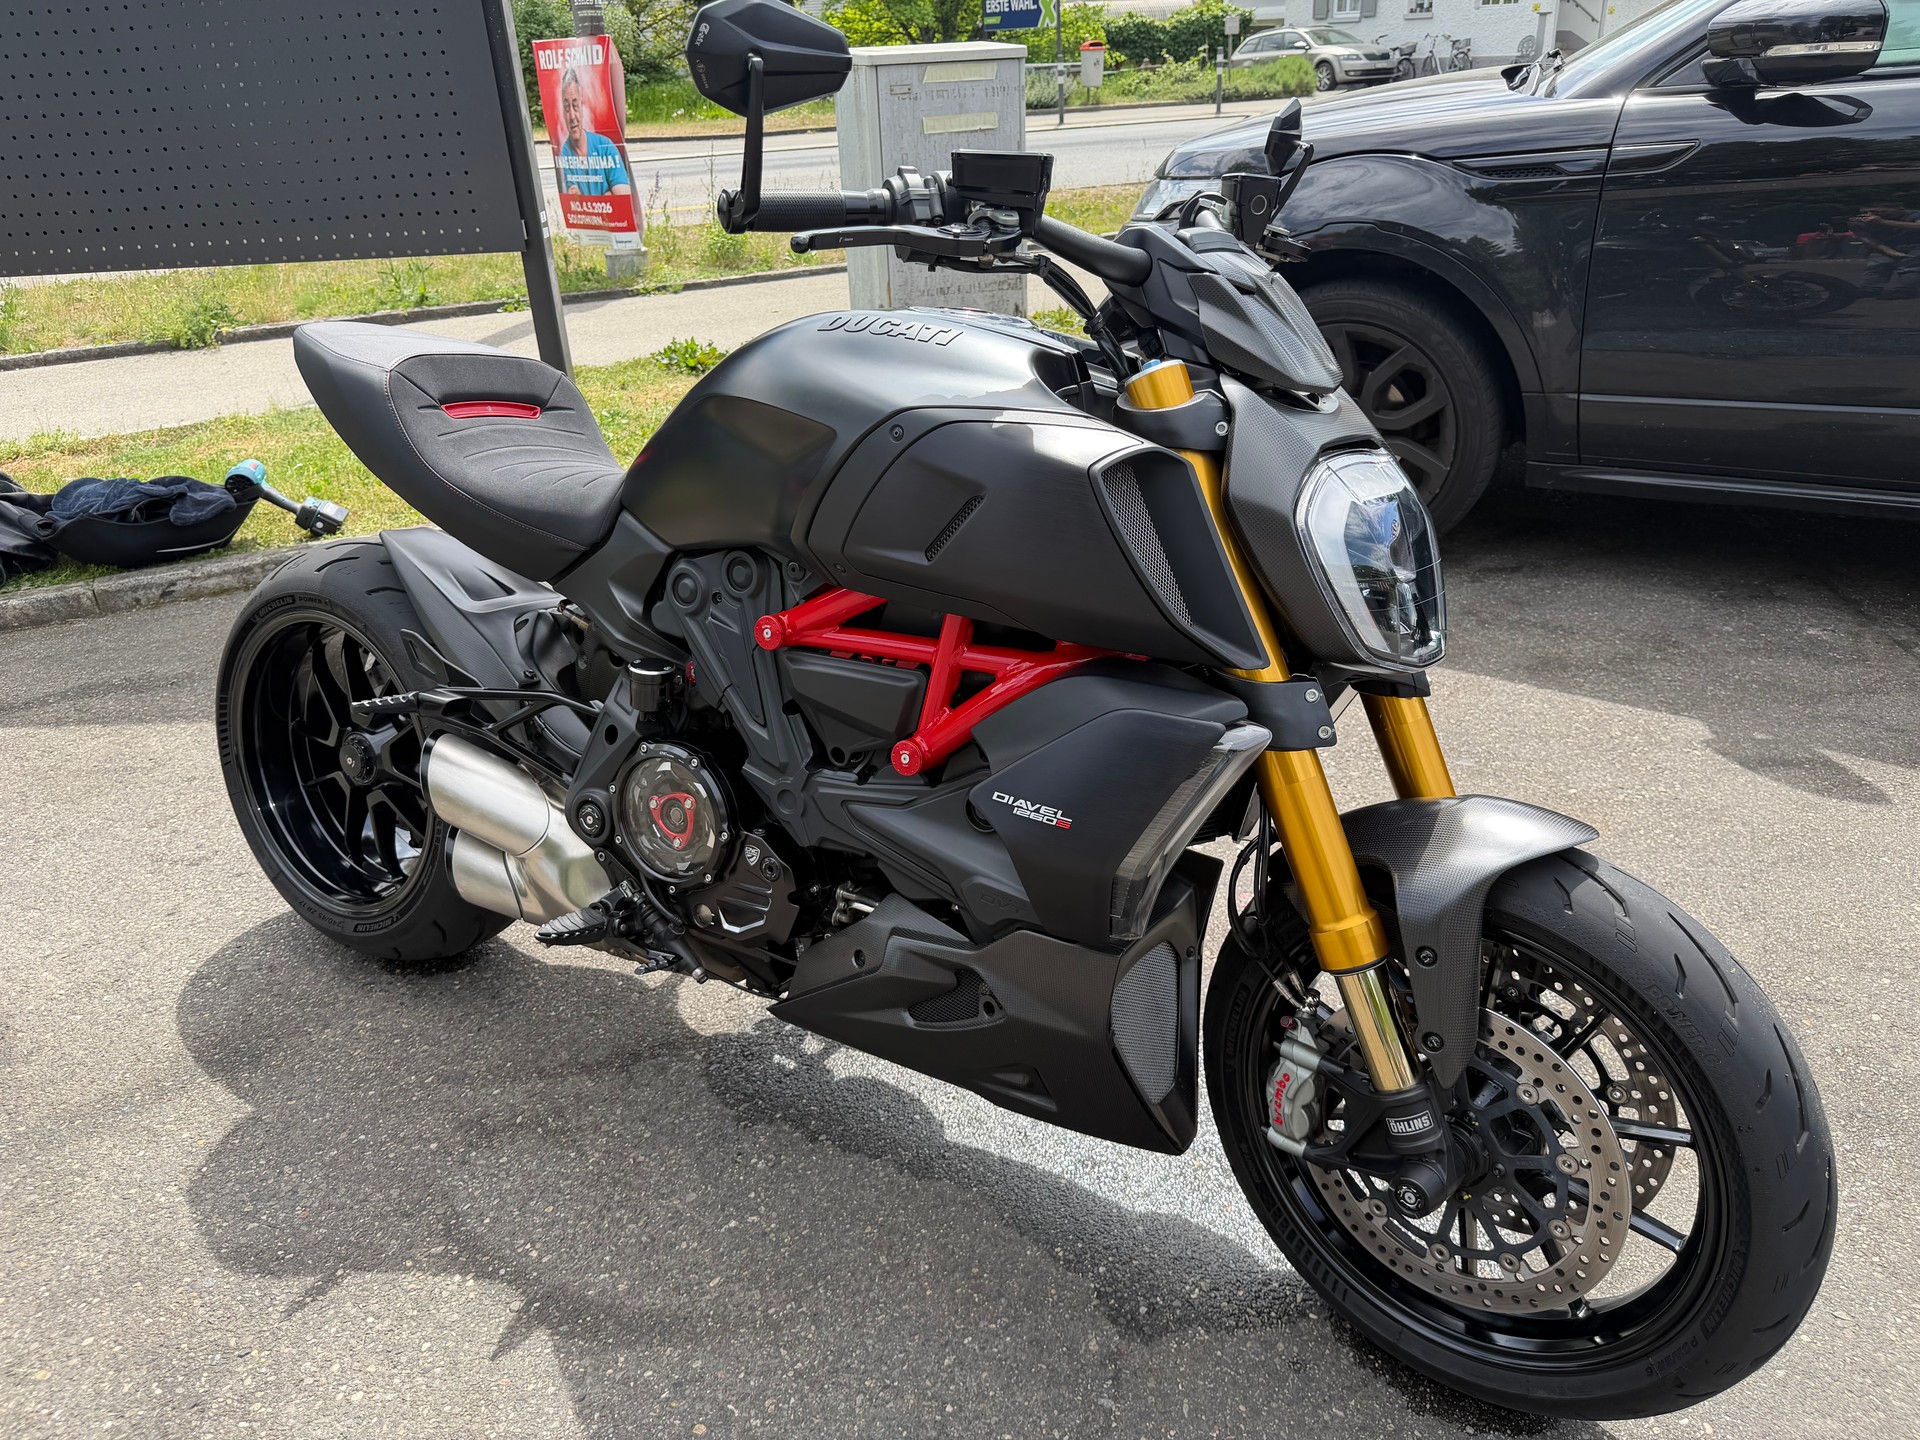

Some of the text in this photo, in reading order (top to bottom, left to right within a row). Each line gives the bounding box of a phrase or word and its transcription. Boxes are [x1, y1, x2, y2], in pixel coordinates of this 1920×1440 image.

[986, 0, 1010, 13] ERSTE
[538, 44, 603, 70] ROLF SCHMID
[816, 315, 964, 346] DUCATI
[260, 596, 294, 618] MICHELIN
[992, 791, 1073, 822] DIAVEL
[1012, 807, 1072, 830] 1260S
[356, 917, 394, 932] MICHELIN
[1226, 989, 1248, 1057] MICHELIN
[1641, 984, 1708, 1052] POWER
[1273, 1072, 1291, 1127] brembo
[1389, 1115, 1431, 1133] ÖHLINS
[1704, 1254, 1746, 1333] MICHELIN
